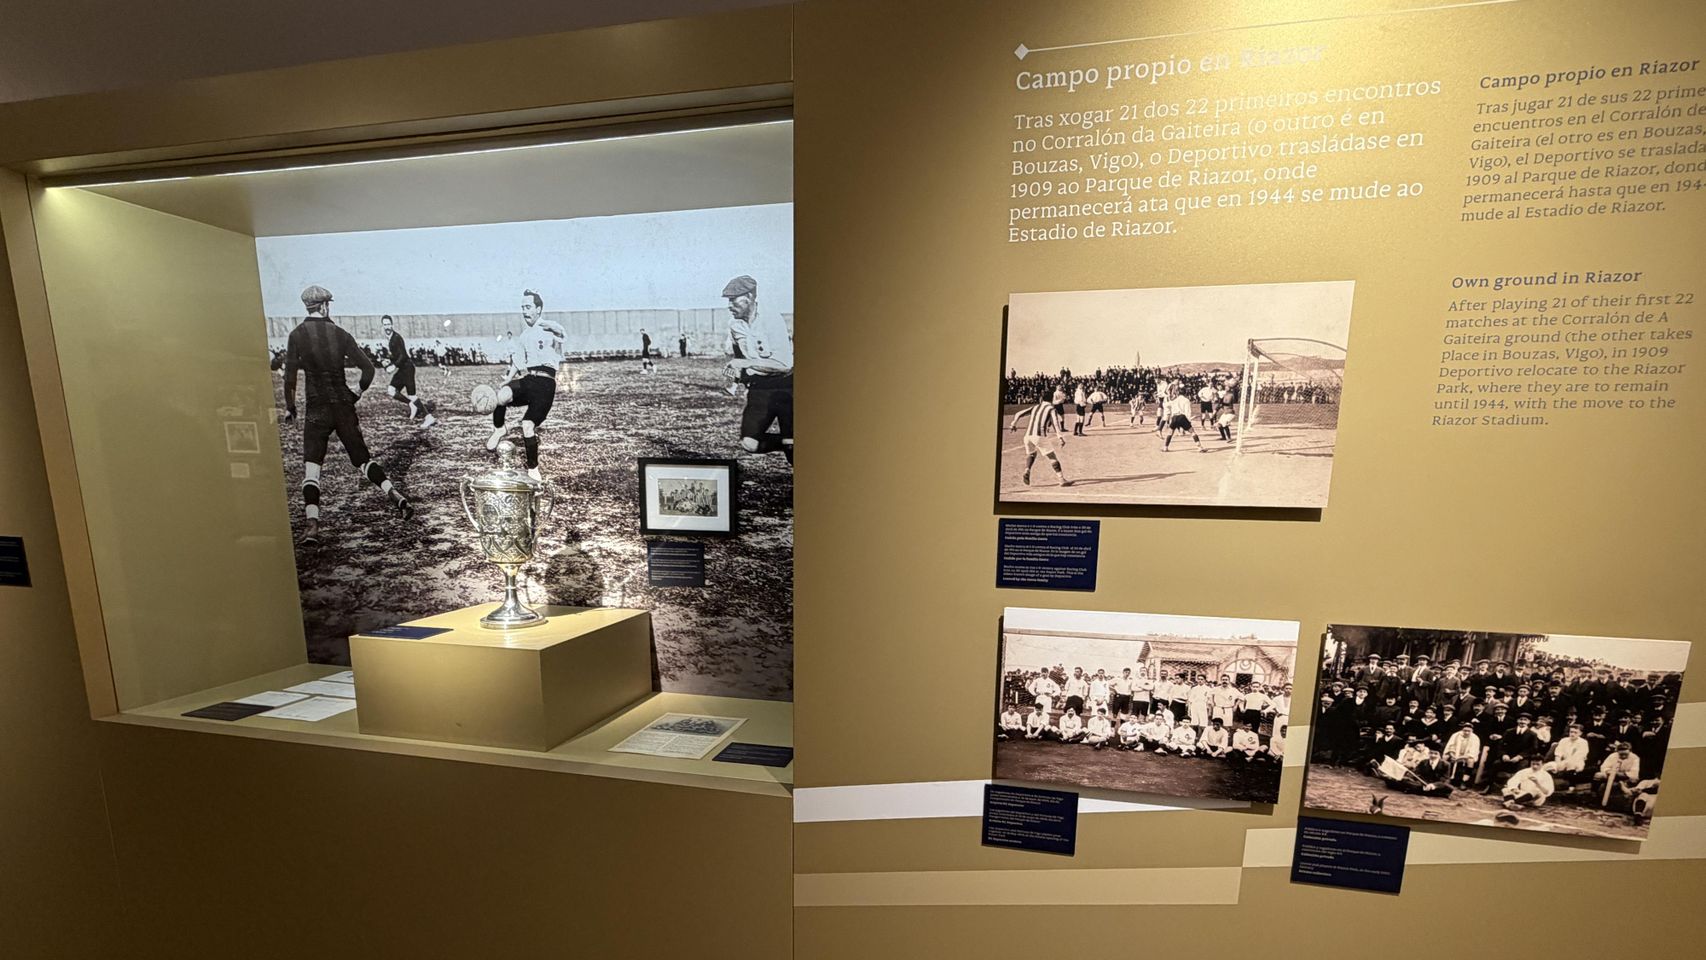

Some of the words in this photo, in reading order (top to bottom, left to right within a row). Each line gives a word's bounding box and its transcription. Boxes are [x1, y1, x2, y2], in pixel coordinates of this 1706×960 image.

[1016, 67, 1099, 92] Campo
[1106, 55, 1191, 89] propio
[1200, 53, 1231, 73] en
[1480, 73, 1540, 90] Campo
[1544, 66, 1606, 87] propio
[1611, 66, 1632, 78] en
[1639, 58, 1700, 75] Riazor
[1014, 114, 1054, 129] Tras
[1059, 108, 1114, 129] xogar
[1119, 105, 1138, 120] 21
[1144, 101, 1180, 119] dos
[1186, 99, 1208, 115] 22
[1215, 90, 1318, 118] primeiros
[1325, 80, 1441, 103] encontros
[1477, 102, 1508, 115] Tras
[1512, 98, 1554, 115] jugar
[1558, 96, 1573, 108] 21
[1577, 93, 1599, 106] de
[1601, 92, 1628, 104] sus
[1632, 90, 1651, 101] 22
[1012, 139, 1036, 153] no
[1042, 129, 1125, 150] Corralón
[1132, 126, 1155, 143] da
[1161, 119, 1240, 141] Gaiteira
[1248, 119, 1267, 135] (o
[1273, 114, 1335, 130] outro
[1341, 109, 1352, 127] é
[1359, 110, 1385, 125] en
[1473, 116, 1563, 133] encuentros
[1567, 115, 1586, 126] en
[1592, 110, 1604, 124] el
[1609, 106, 1682, 123] Corralón
[1471, 134, 1531, 151] Gaiteira
[1535, 132, 1554, 147] (el
[1558, 131, 1592, 143] otro
[1597, 130, 1613, 141] es
[1618, 128, 1637, 140] en
[1012, 159, 1083, 175] Bouzas,
[1090, 152, 1144, 173] Vigo),
[1150, 152, 1161, 165] o
[1168, 141, 1272, 167] Deportivo
[1279, 133, 1390, 156] trasládase
[1396, 132, 1424, 147] en
[1469, 154, 1511, 171] Vigo),
[1516, 153, 1529, 165] el
[1533, 147, 1613, 168] Deportivo
[1618, 146, 1635, 158] se
[1011, 182, 1052, 198] 1909
[1058, 182, 1079, 195] ao
[1085, 176, 1152, 196] Parque
[1158, 171, 1182, 188] de
[1188, 168, 1257, 185] Riazor,
[1263, 162, 1317, 181] onde
[1466, 174, 1500, 186] 1909
[1504, 170, 1517, 184] al
[1522, 169, 1576, 185] Parque
[1580, 162, 1600, 179] de
[1604, 163, 1660, 177] Riazor,
[1009, 196, 1132, 225] permanecerá
[1138, 199, 1169, 213] ata
[1175, 194, 1211, 215] que
[1217, 194, 1242, 207] en
[1249, 188, 1294, 206] 1944
[1301, 188, 1324, 202] se
[1329, 181, 1391, 201] mude
[1397, 182, 1423, 197] ao
[1462, 185, 1563, 208] permanecerá
[1568, 183, 1612, 198] hasta
[1616, 183, 1646, 198] que
[1650, 182, 1669, 193] en
[1675, 177, 1706, 191] 194
[1461, 209, 1504, 221] mude
[1507, 206, 1520, 219] al
[1525, 203, 1583, 218] Estadio
[1587, 202, 1606, 215] de
[1611, 200, 1666, 213] Riazor.
[1009, 224, 1078, 242] Estadio
[1083, 222, 1105, 239] de
[1111, 219, 1177, 236] Riazor.
[1452, 277, 1489, 289] Own
[1493, 271, 1557, 290] ground
[1562, 272, 1579, 285] in
[1585, 270, 1642, 283] Riazor
[1448, 300, 1487, 312] After
[1492, 297, 1547, 313] playing
[1552, 298, 1566, 308] 21
[1571, 295, 1588, 307] of
[1592, 295, 1631, 307] their
[1635, 293, 1670, 305] first
[1675, 294, 1694, 304] 22
[1446, 315, 1508, 329] matches
[1512, 316, 1528, 326] at
[1532, 315, 1557, 326] the
[1562, 311, 1630, 325] Corralón
[1634, 312, 1654, 323] de
[1658, 313, 1668, 323] A
[1443, 333, 1500, 345] Gaiteira
[1504, 331, 1560, 347] ground
[1565, 331, 1597, 344] (the
[1601, 330, 1645, 342] other
[1650, 329, 1693, 340] takes
[1441, 349, 1479, 363] place
[1483, 349, 1497, 361] in
[1502, 348, 1560, 361] Bouzas,
[1565, 347, 1607, 362] Vigo),
[1613, 346, 1626, 358] in
[1632, 347, 1668, 358] 1909
[1439, 365, 1512, 381] Deportivo
[1517, 364, 1578, 377] relocate
[1583, 365, 1599, 375] to
[1604, 363, 1629, 374] the
[1634, 362, 1686, 374] Riazor
[1437, 383, 1473, 394] Park,
[1478, 382, 1522, 393] where
[1527, 381, 1562, 395] they
[1565, 382, 1589, 392] are
[1594, 381, 1609, 391] to
[1613, 381, 1668, 391] remain
[1434, 398, 1469, 410] until
[1474, 399, 1508, 410] 1944,
[1514, 397, 1547, 409] with
[1553, 397, 1577, 409] the
[1583, 399, 1623, 409] move
[1629, 398, 1645, 408] to
[1650, 397, 1675, 408] the
[1432, 415, 1478, 426] Riazor
[1482, 414, 1548, 425] Stadium.
